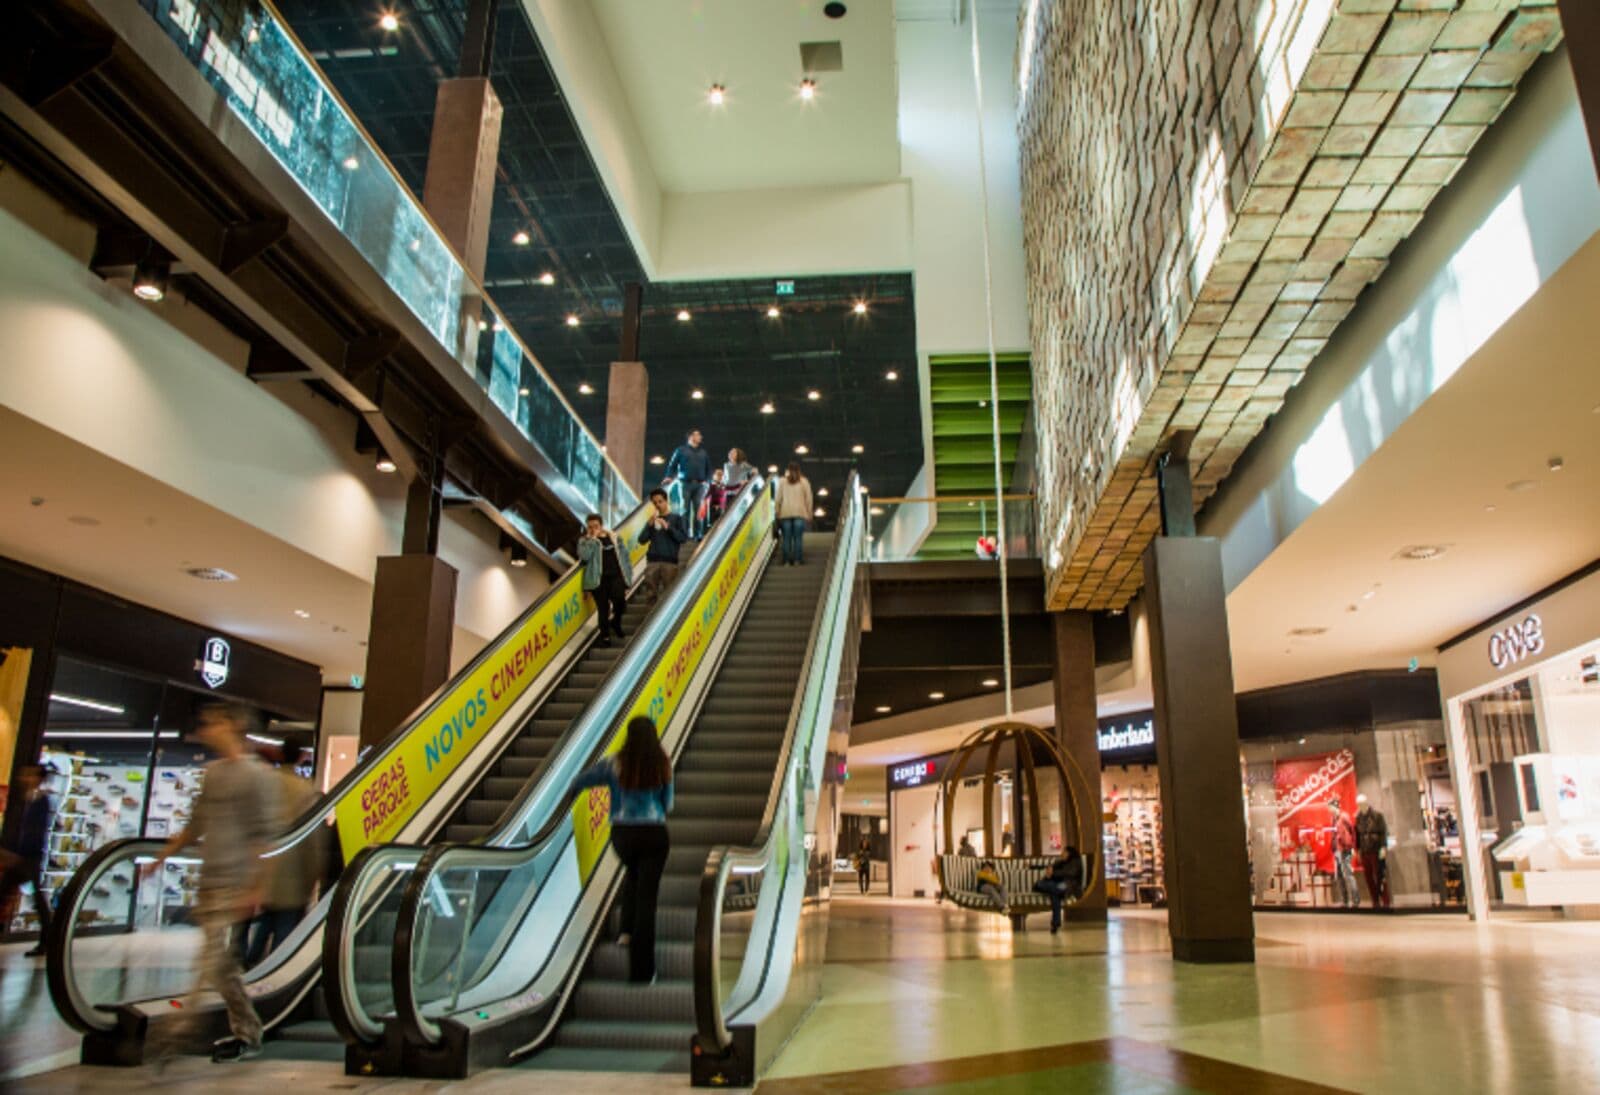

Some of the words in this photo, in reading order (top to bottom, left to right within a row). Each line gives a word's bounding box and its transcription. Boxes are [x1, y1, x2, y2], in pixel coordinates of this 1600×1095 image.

[424, 688, 487, 773] NOVOS
[489, 624, 553, 702] CINEMAS.
[553, 592, 581, 637] MAIS
[1097, 719, 1154, 751] imberland
[362, 776, 410, 840] PARQUE
